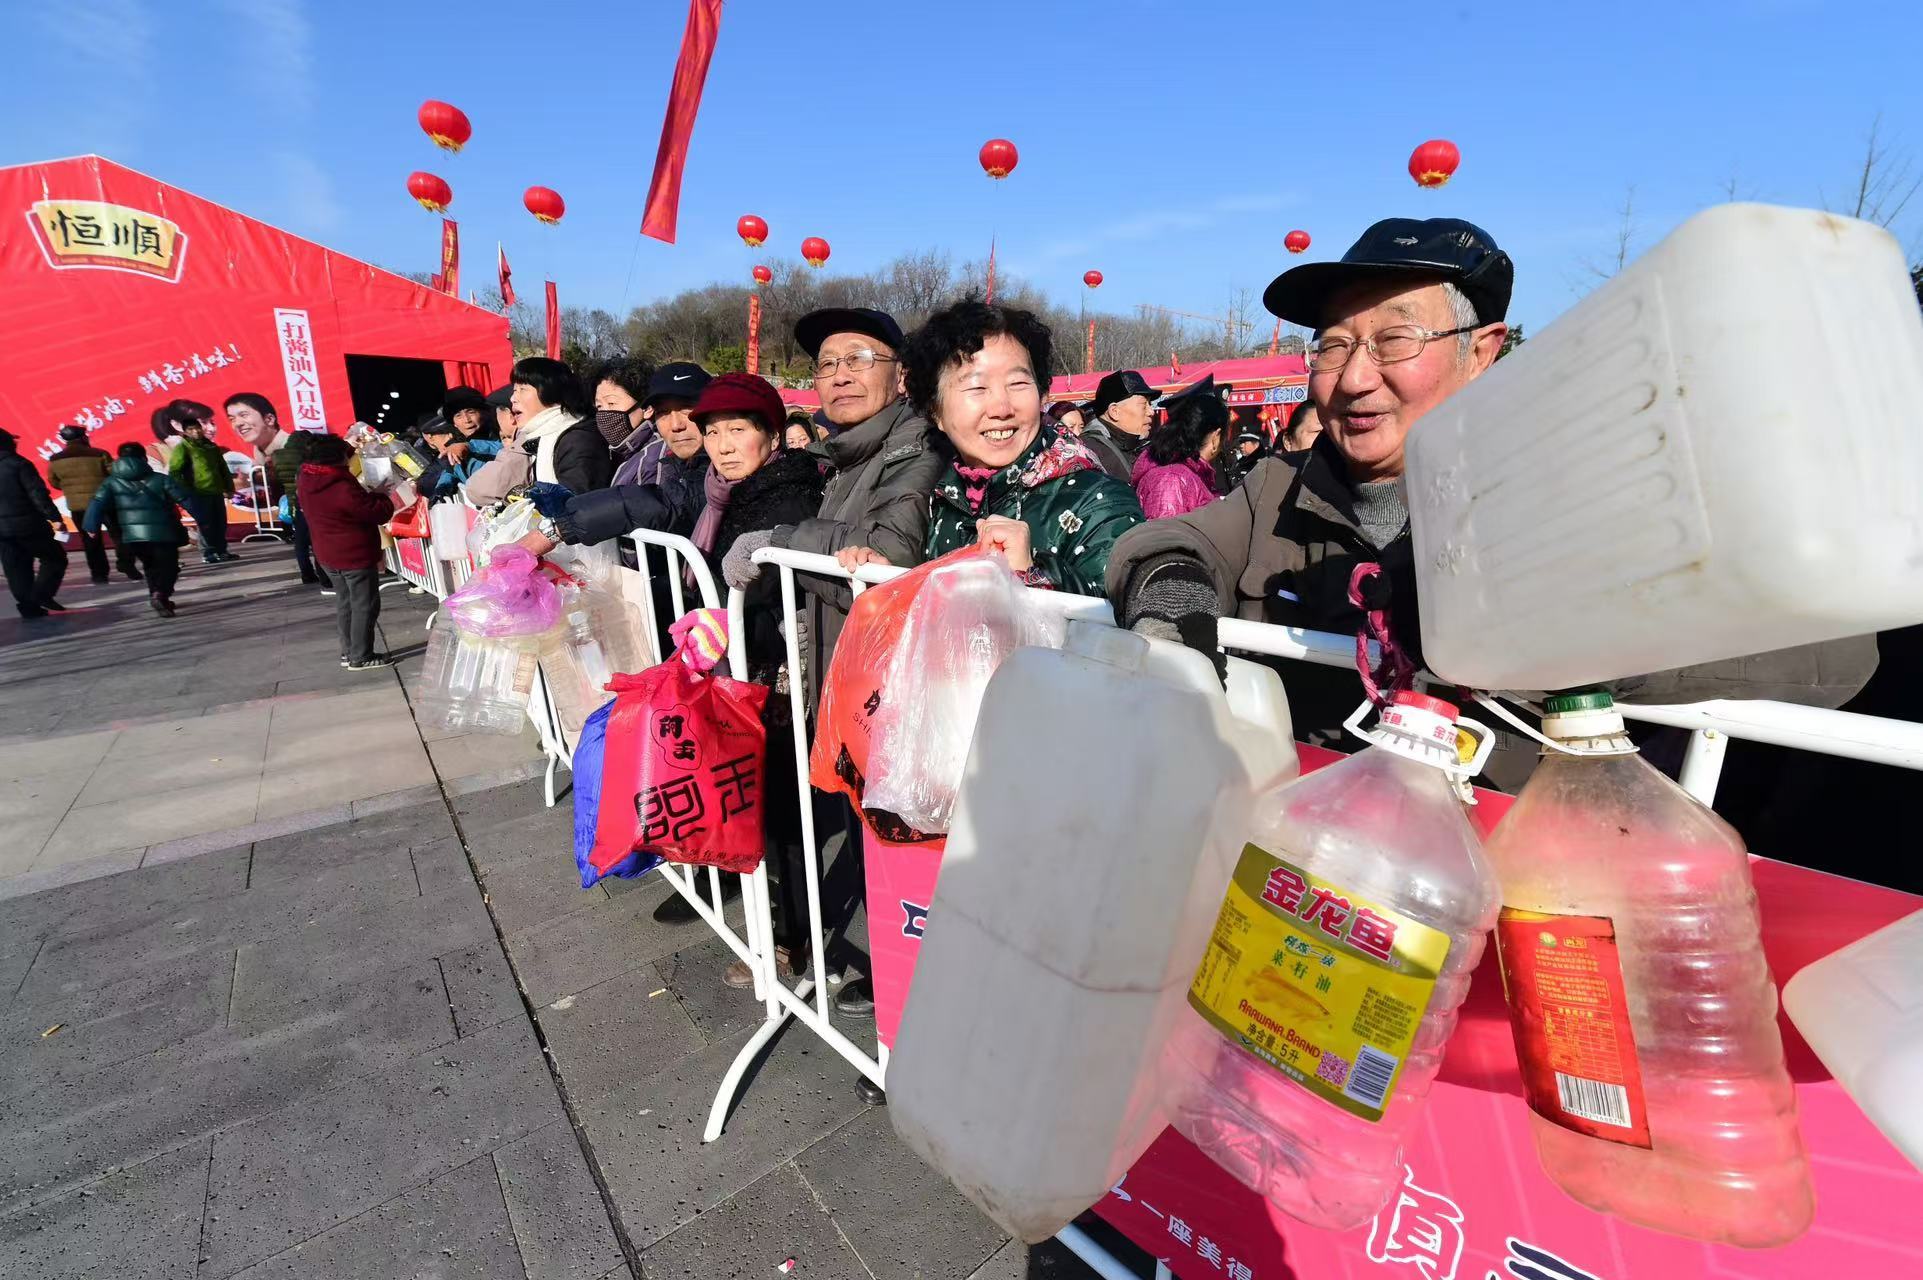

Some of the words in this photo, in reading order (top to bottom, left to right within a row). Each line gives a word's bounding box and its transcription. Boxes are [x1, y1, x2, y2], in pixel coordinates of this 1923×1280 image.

[50, 208, 165, 259] 恒順
[1260, 867, 1399, 963] 金龙鱼
[1271, 949, 1332, 994] 菜籽油
